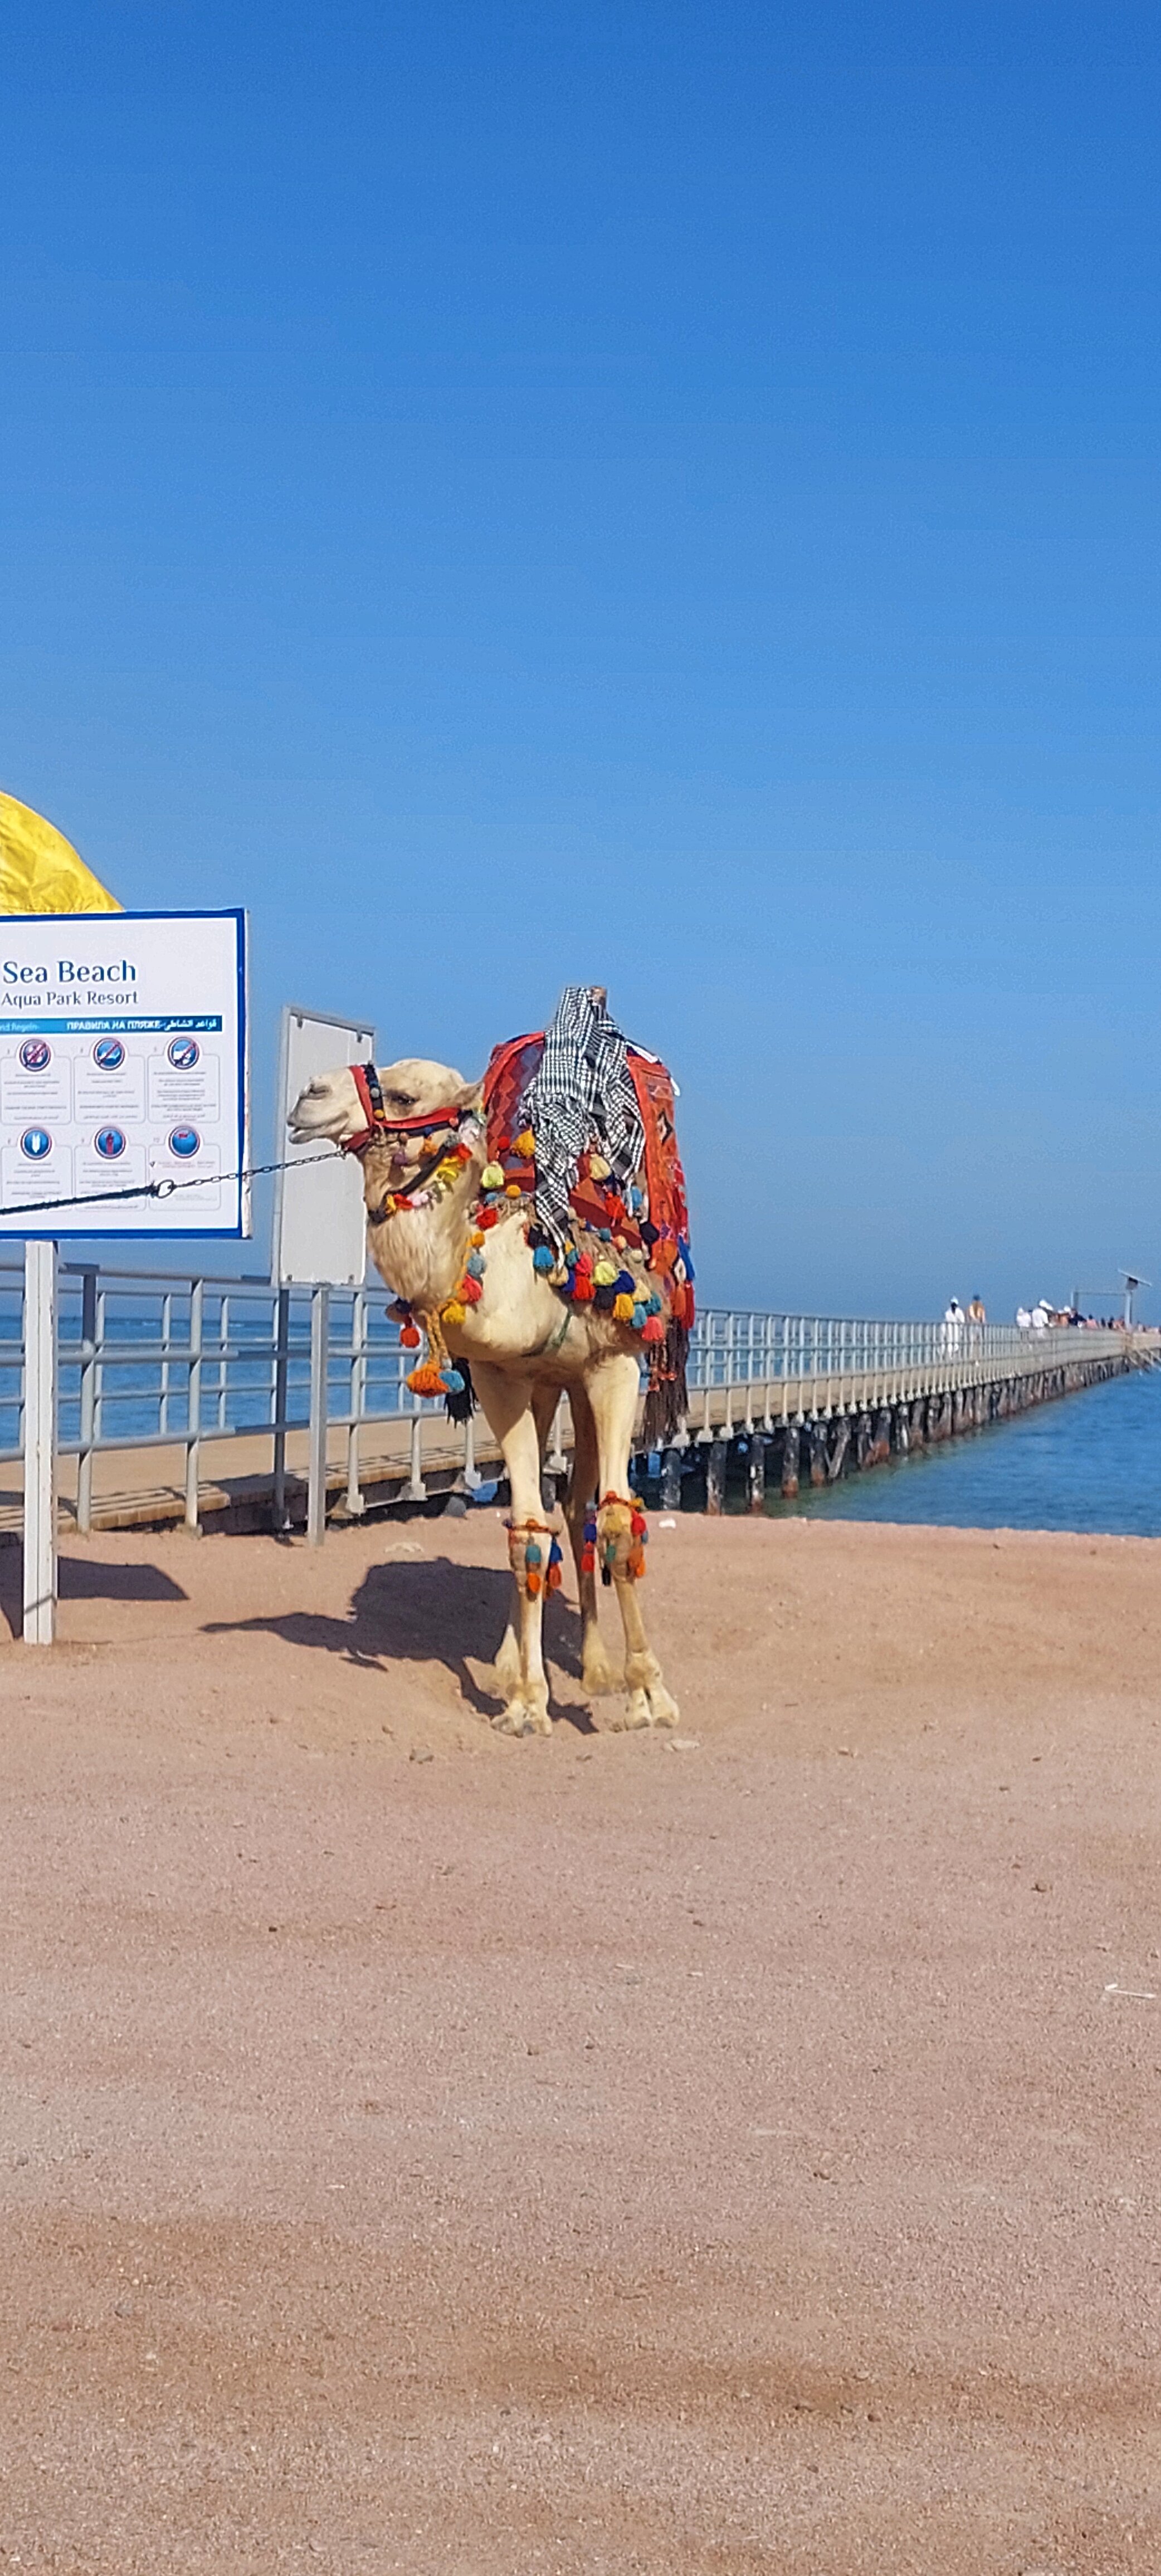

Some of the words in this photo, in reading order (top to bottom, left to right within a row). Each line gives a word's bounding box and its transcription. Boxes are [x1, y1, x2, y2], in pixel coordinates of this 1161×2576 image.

[3, 961, 48, 984] Sea
[57, 959, 136, 983] Beach
[2, 992, 41, 1009] Aqua
[47, 991, 81, 1006] Park
[87, 991, 139, 1005] Resort
[66, 1021, 110, 1031] ПРАВИЛА
[111, 1020, 125, 1030] НА
